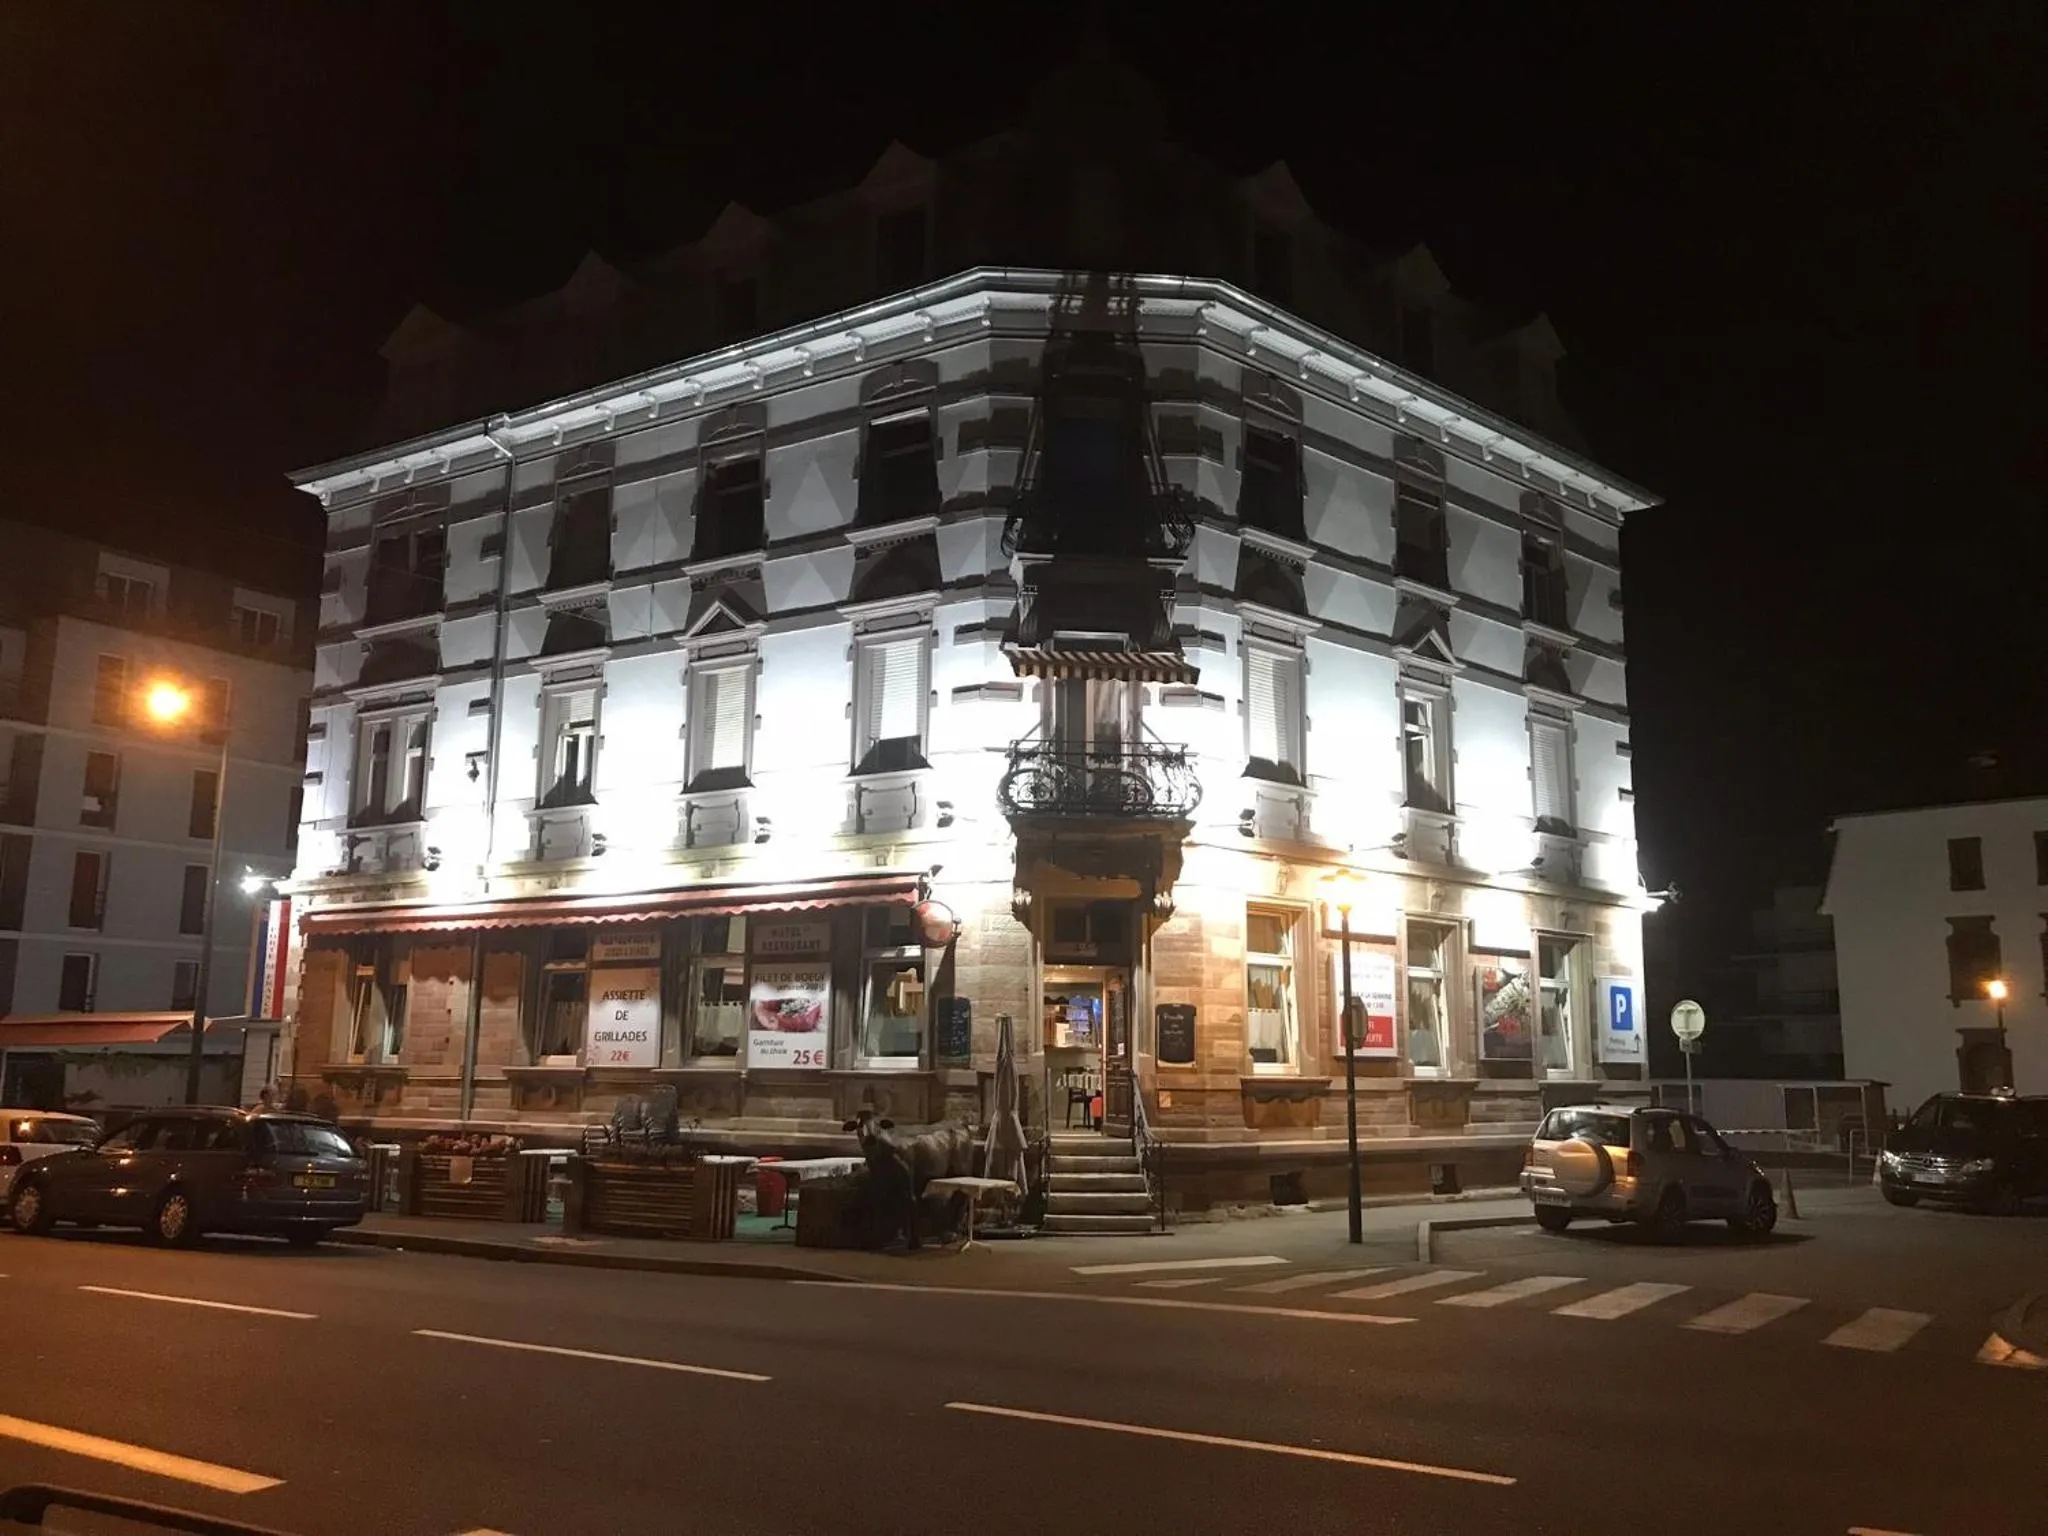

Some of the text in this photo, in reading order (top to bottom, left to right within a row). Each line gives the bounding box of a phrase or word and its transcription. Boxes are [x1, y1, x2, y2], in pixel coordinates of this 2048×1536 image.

[780, 972, 793, 982] DE
[603, 989, 647, 1000] ASSIETTE
[1615, 993, 1627, 1024] P
[615, 1010, 630, 1021] DE
[594, 1030, 648, 1042] GRILLADES
[611, 1050, 632, 1061] 22€
